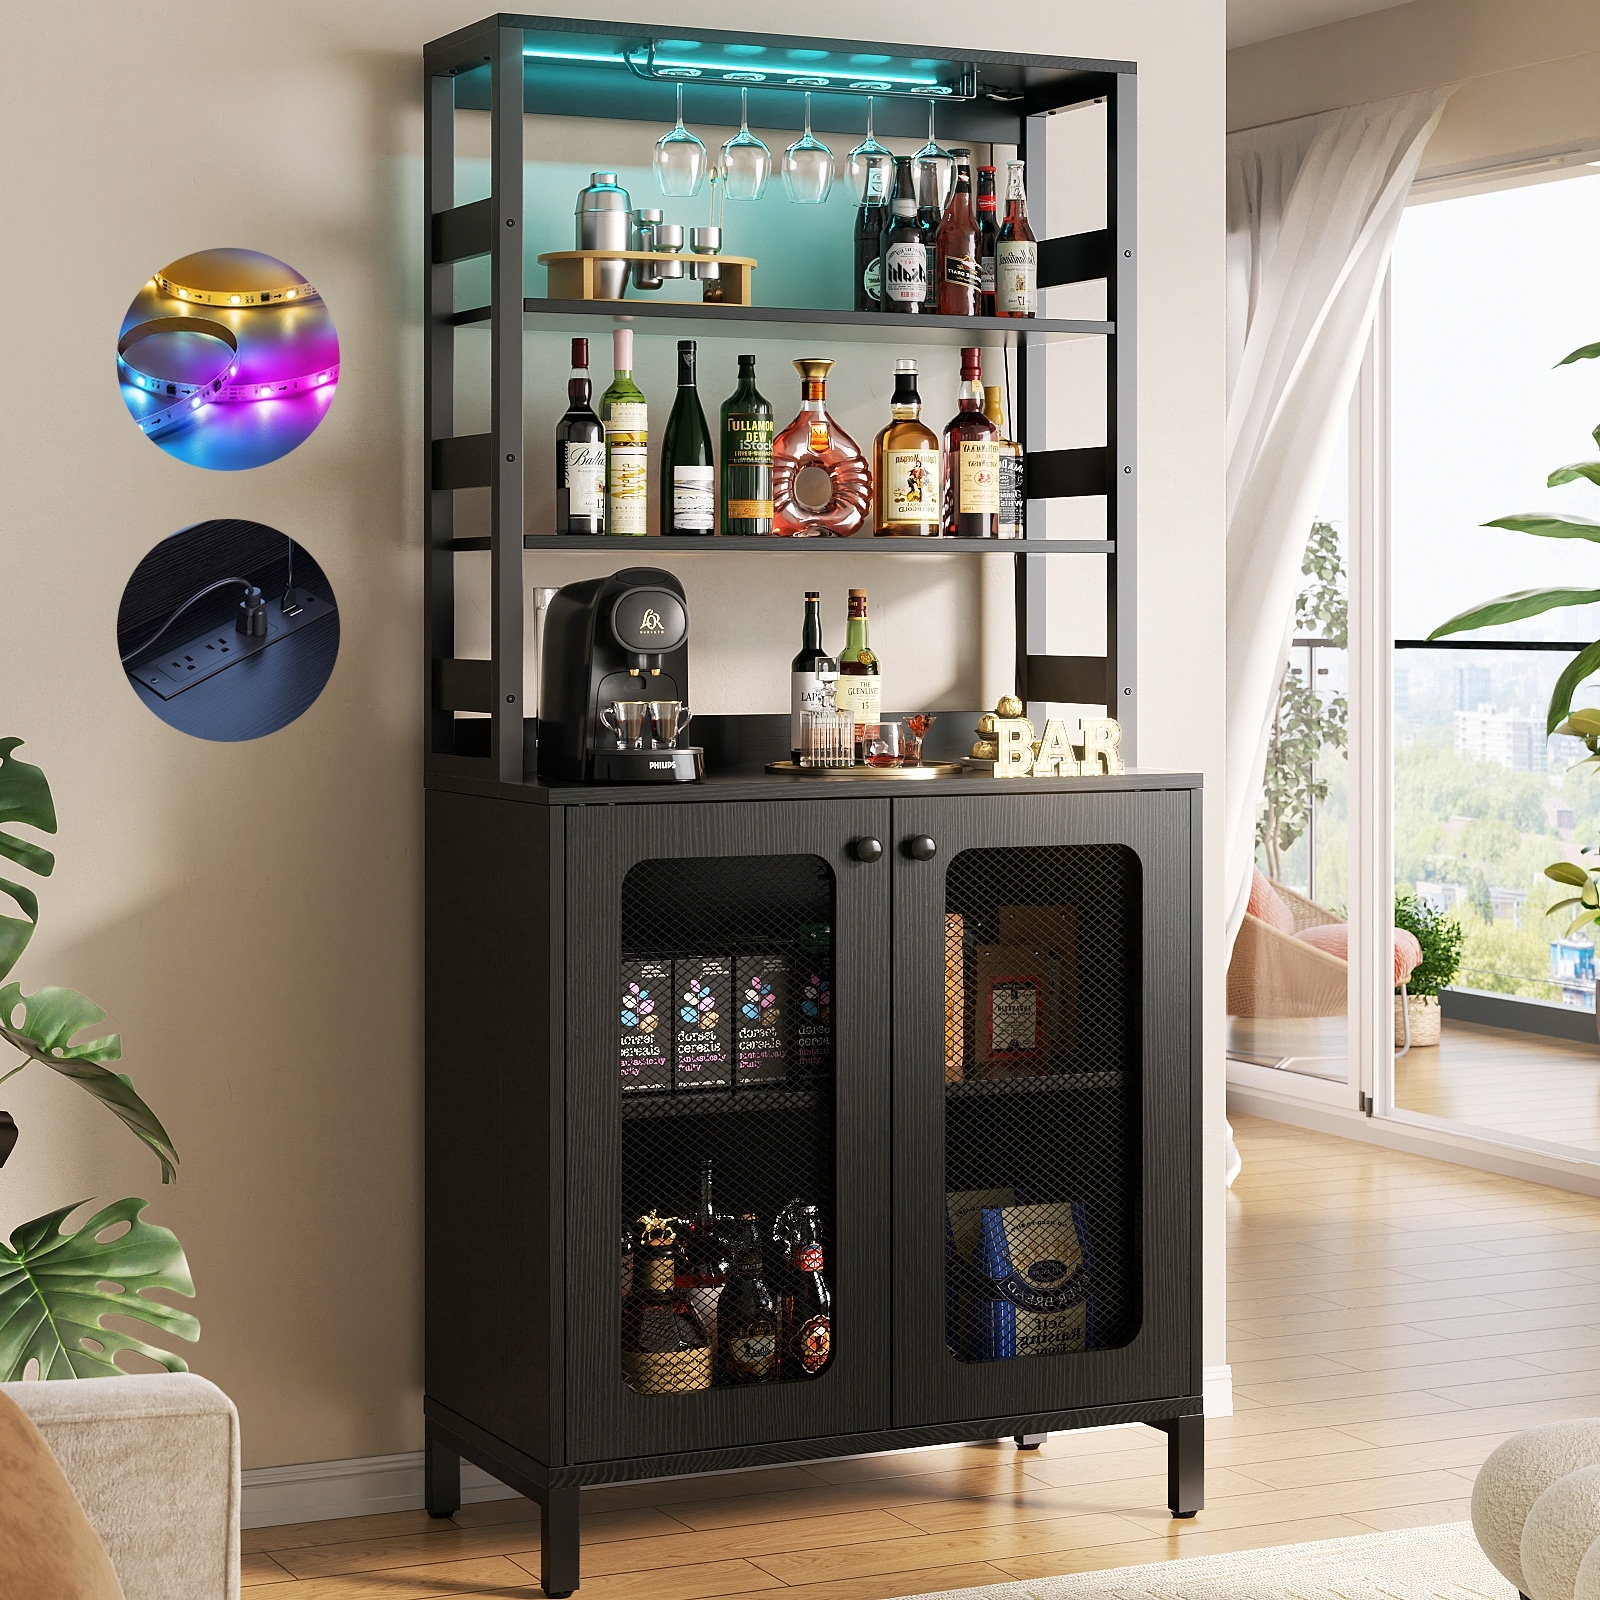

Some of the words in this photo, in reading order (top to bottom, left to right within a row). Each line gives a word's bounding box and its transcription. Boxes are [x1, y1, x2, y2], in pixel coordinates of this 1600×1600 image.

[745, 431, 767, 443] DEW
[862, 701, 870, 710] 15
[993, 718, 1125, 778] BAR
[648, 761, 677, 770] PHILIPS
[677, 1030, 717, 1042] dorset
[739, 1027, 777, 1039] dorset
[677, 1041, 721, 1054] cereals
